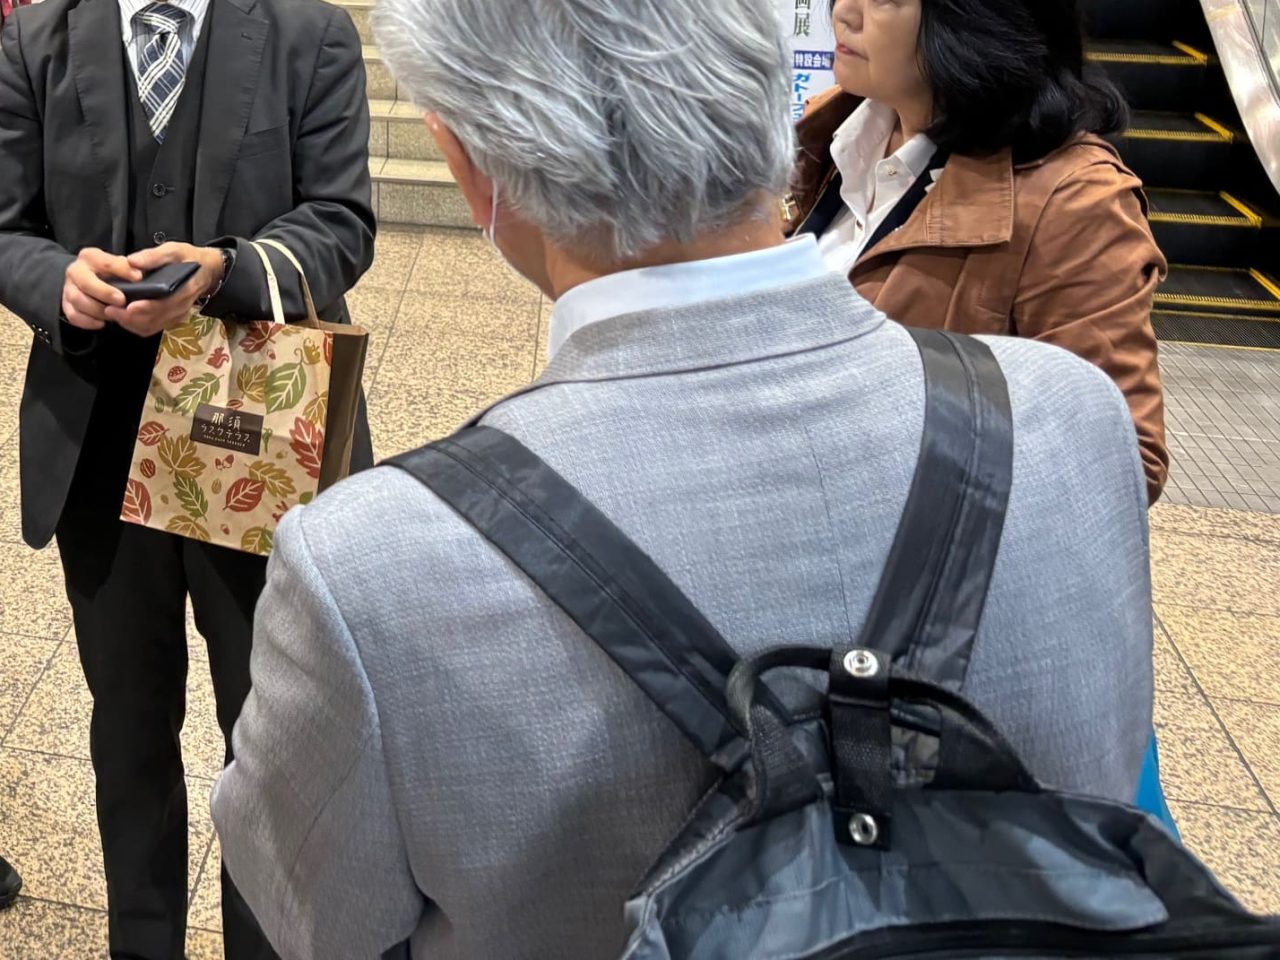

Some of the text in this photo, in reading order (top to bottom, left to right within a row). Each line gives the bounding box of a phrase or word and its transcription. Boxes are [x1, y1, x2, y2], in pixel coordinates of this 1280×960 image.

[211, 412, 241, 430] 那須
[201, 423, 250, 443] ラスクテラス
